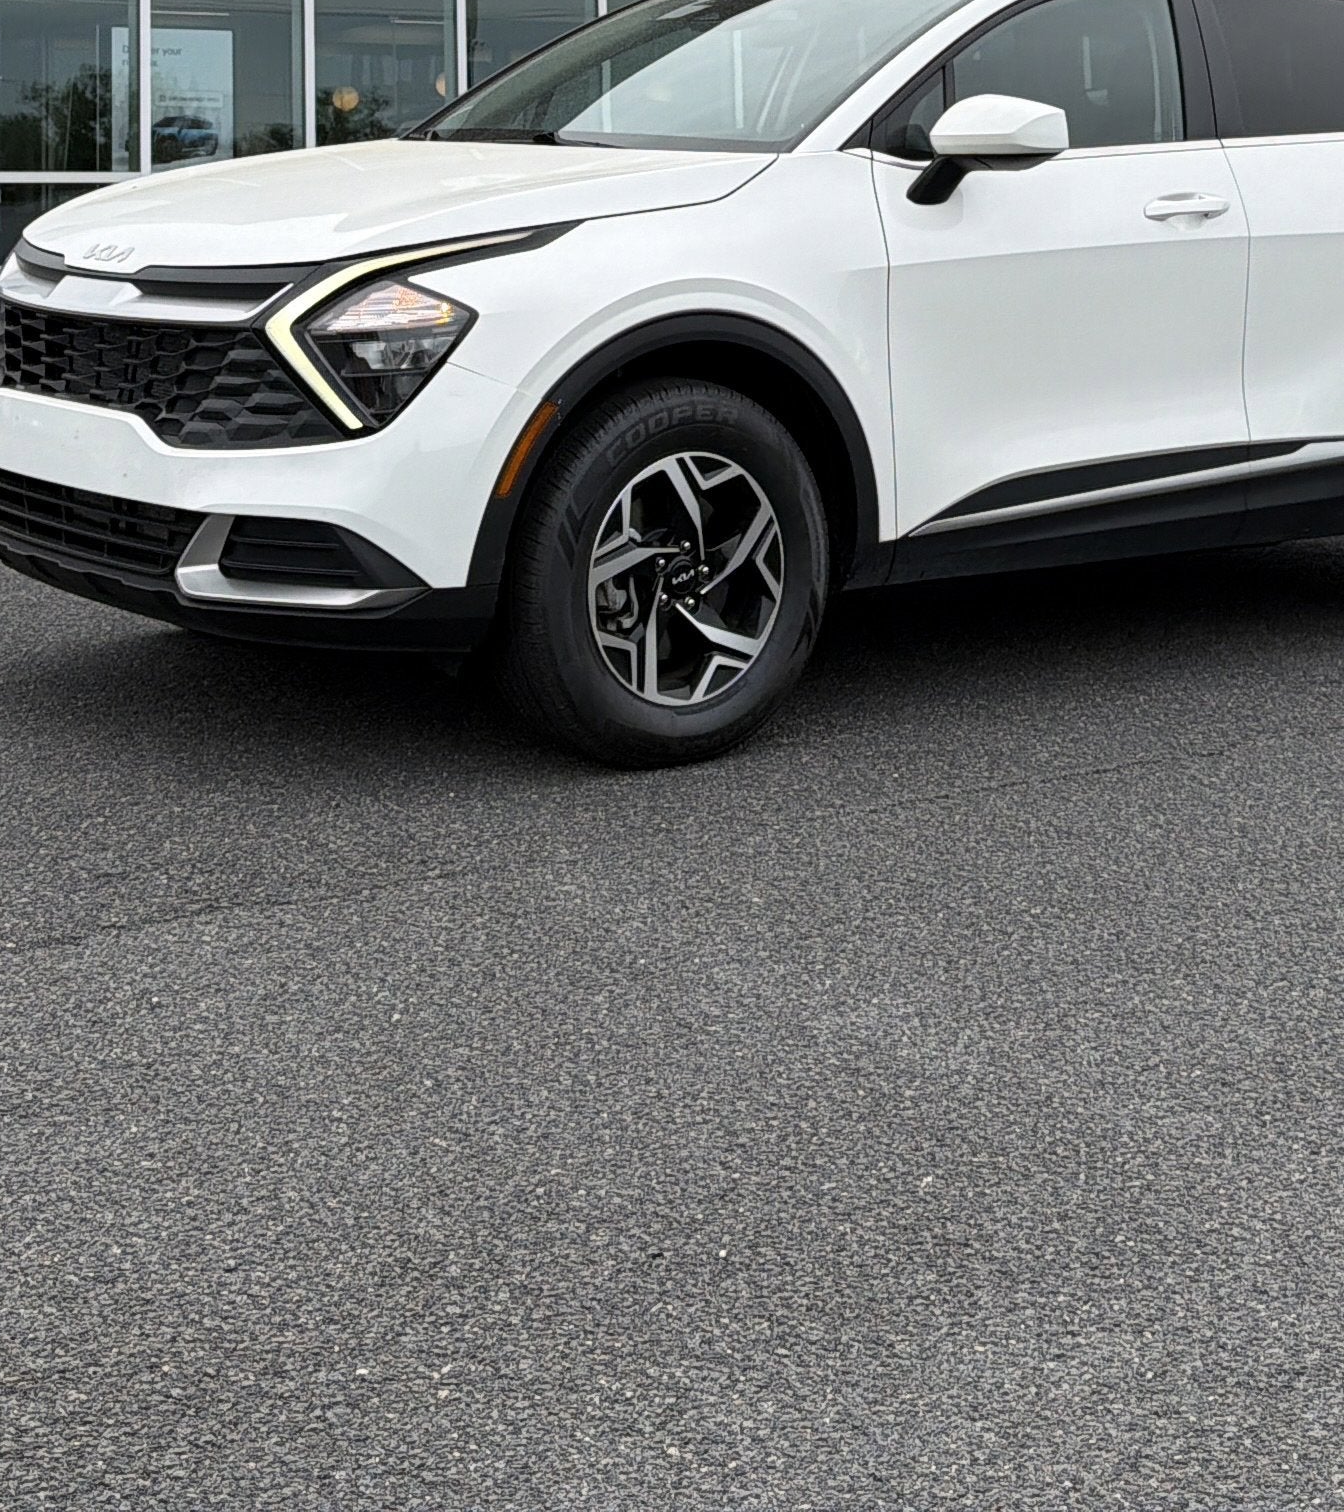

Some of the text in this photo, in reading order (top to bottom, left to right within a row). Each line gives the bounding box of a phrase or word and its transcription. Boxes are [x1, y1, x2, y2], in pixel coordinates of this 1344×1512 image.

[83, 243, 135, 263] KIA
[606, 404, 739, 467] COOPER
[671, 568, 695, 585] KIA
